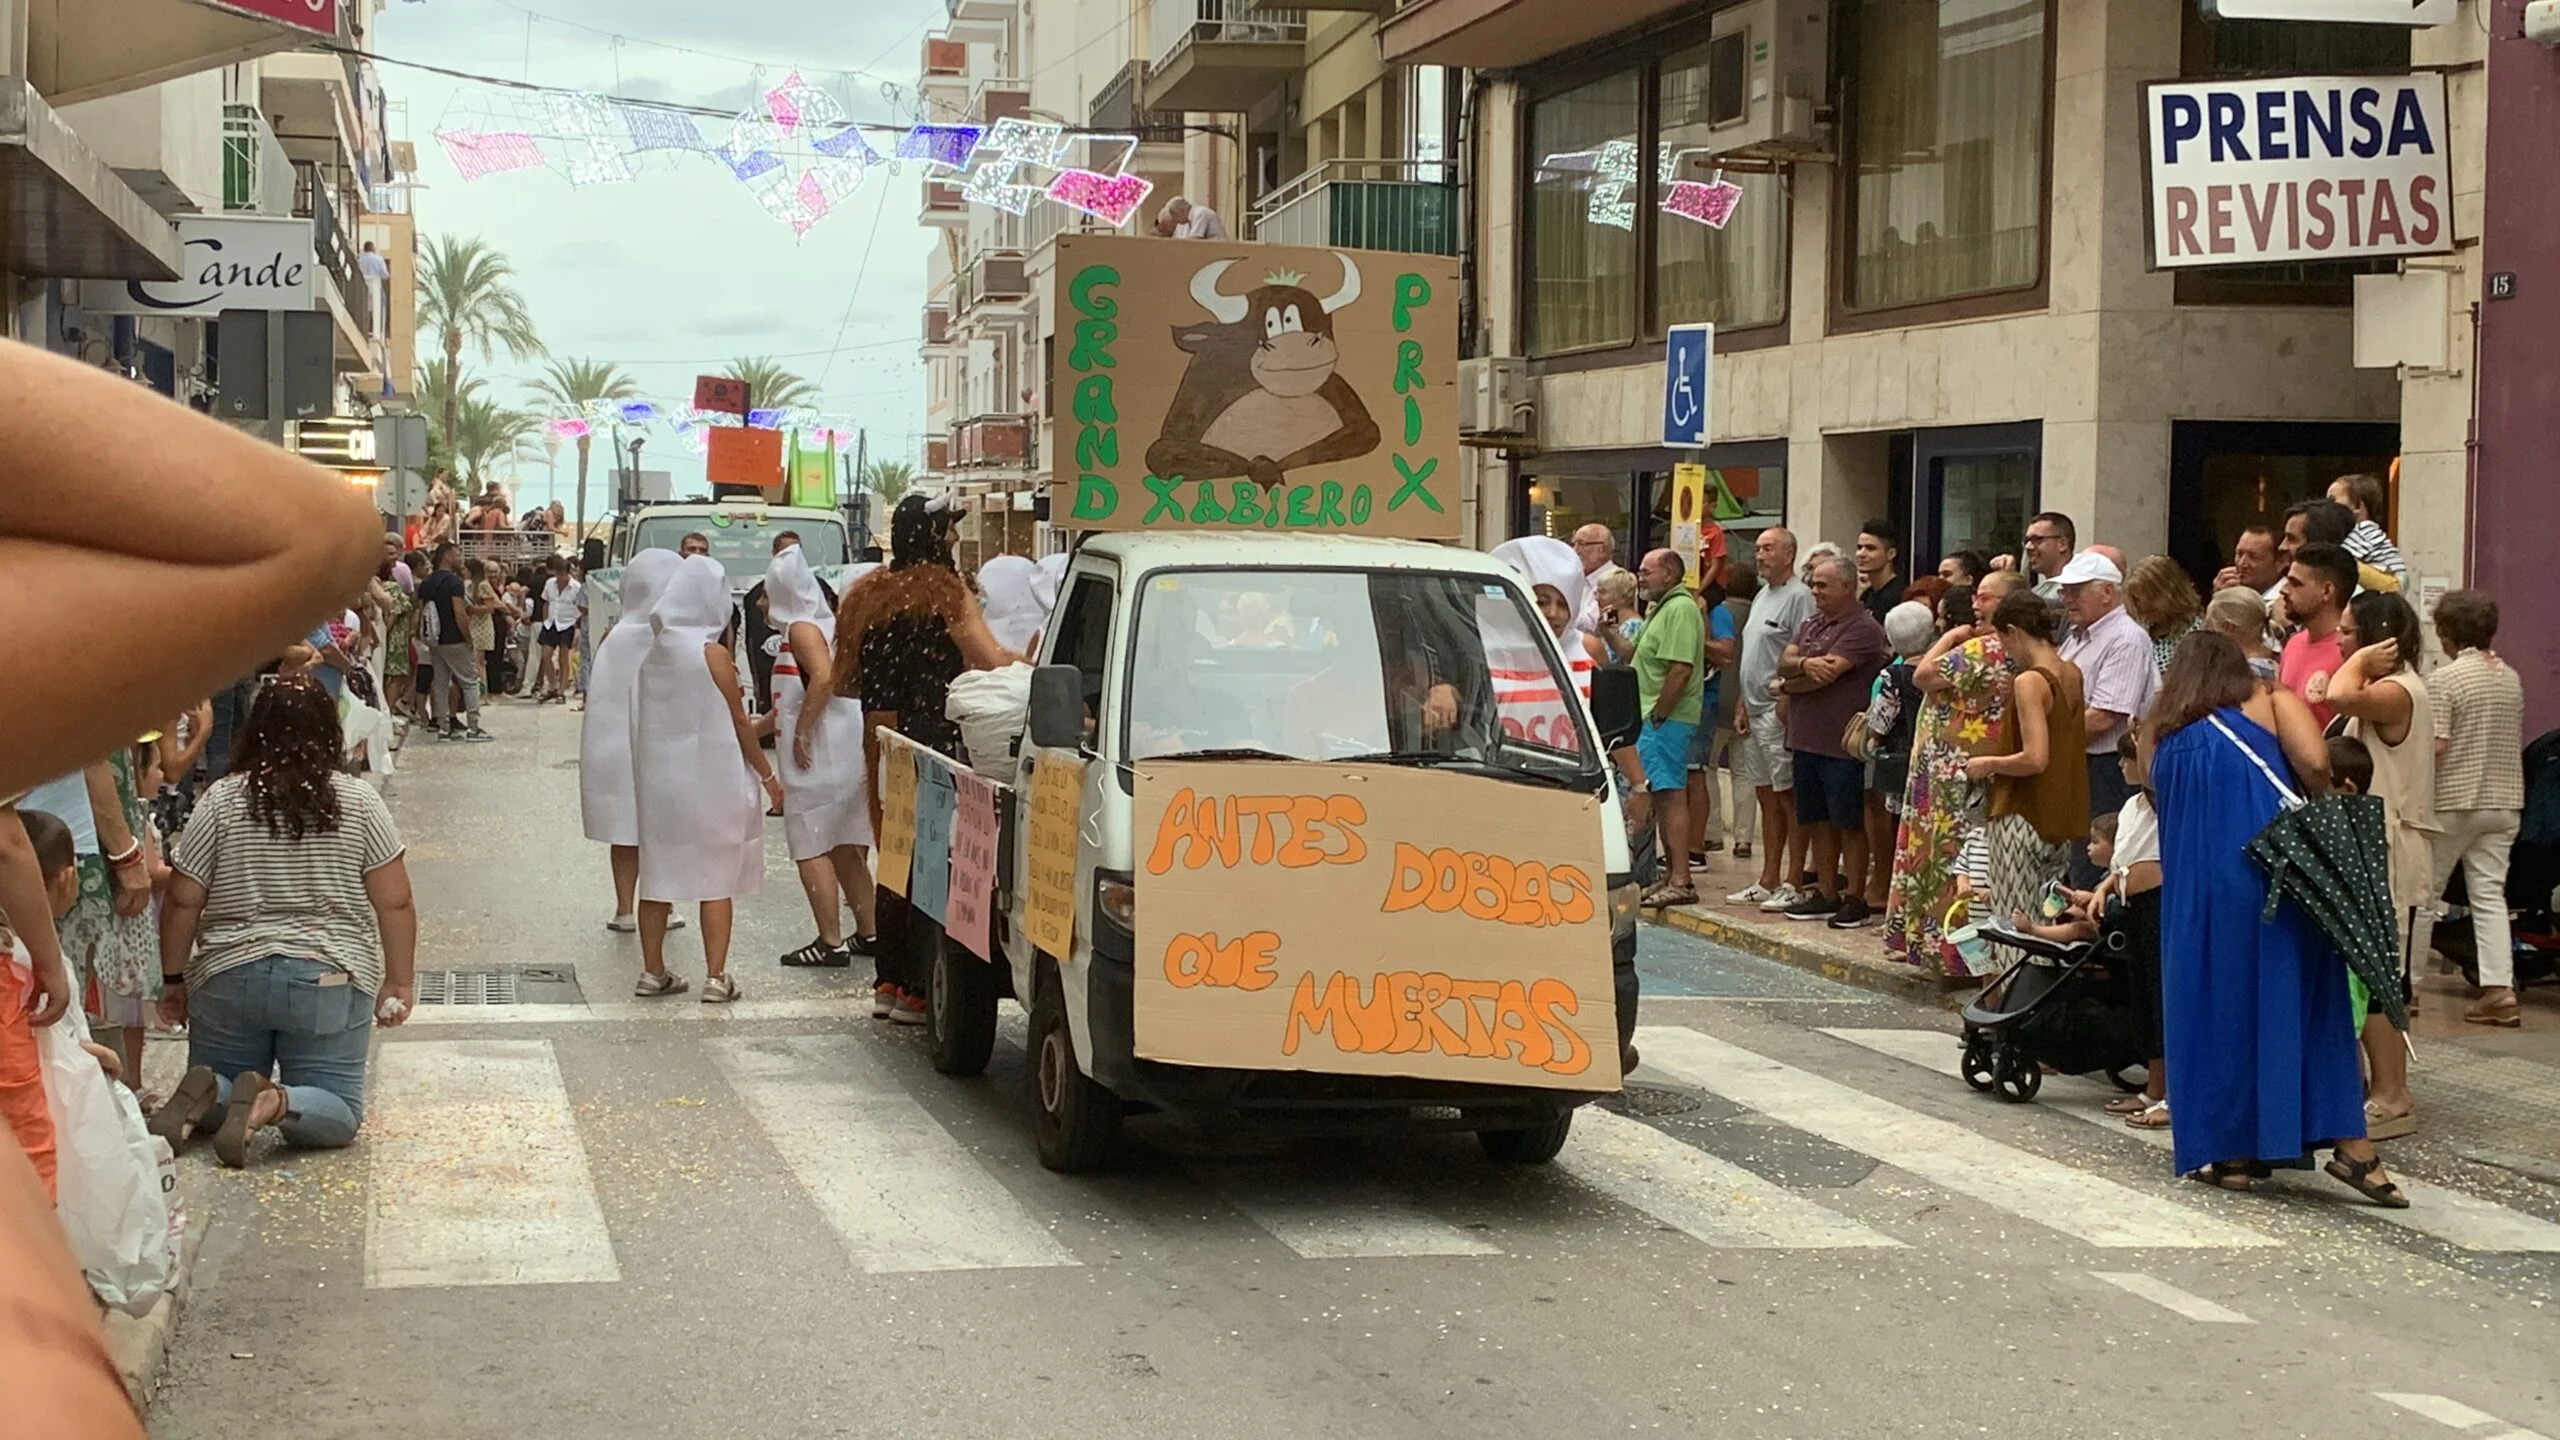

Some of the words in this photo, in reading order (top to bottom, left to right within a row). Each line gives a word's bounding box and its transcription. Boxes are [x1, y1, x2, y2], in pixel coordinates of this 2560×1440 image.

[2161, 86, 2434, 165] PRENSA
[2165, 174, 2441, 257] REVISTAS
[127, 238, 304, 309] Cande
[2493, 275, 2509, 296] 15
[1068, 264, 1119, 520] GRAND
[1387, 273, 1444, 514] PRIX
[1142, 475, 1372, 526] XABIERO
[1147, 787, 1367, 875] ANTES
[1380, 841, 1595, 927] DOBLAS
[1163, 930, 1281, 991] QUE
[1282, 970, 1592, 1075] MUERTAS
